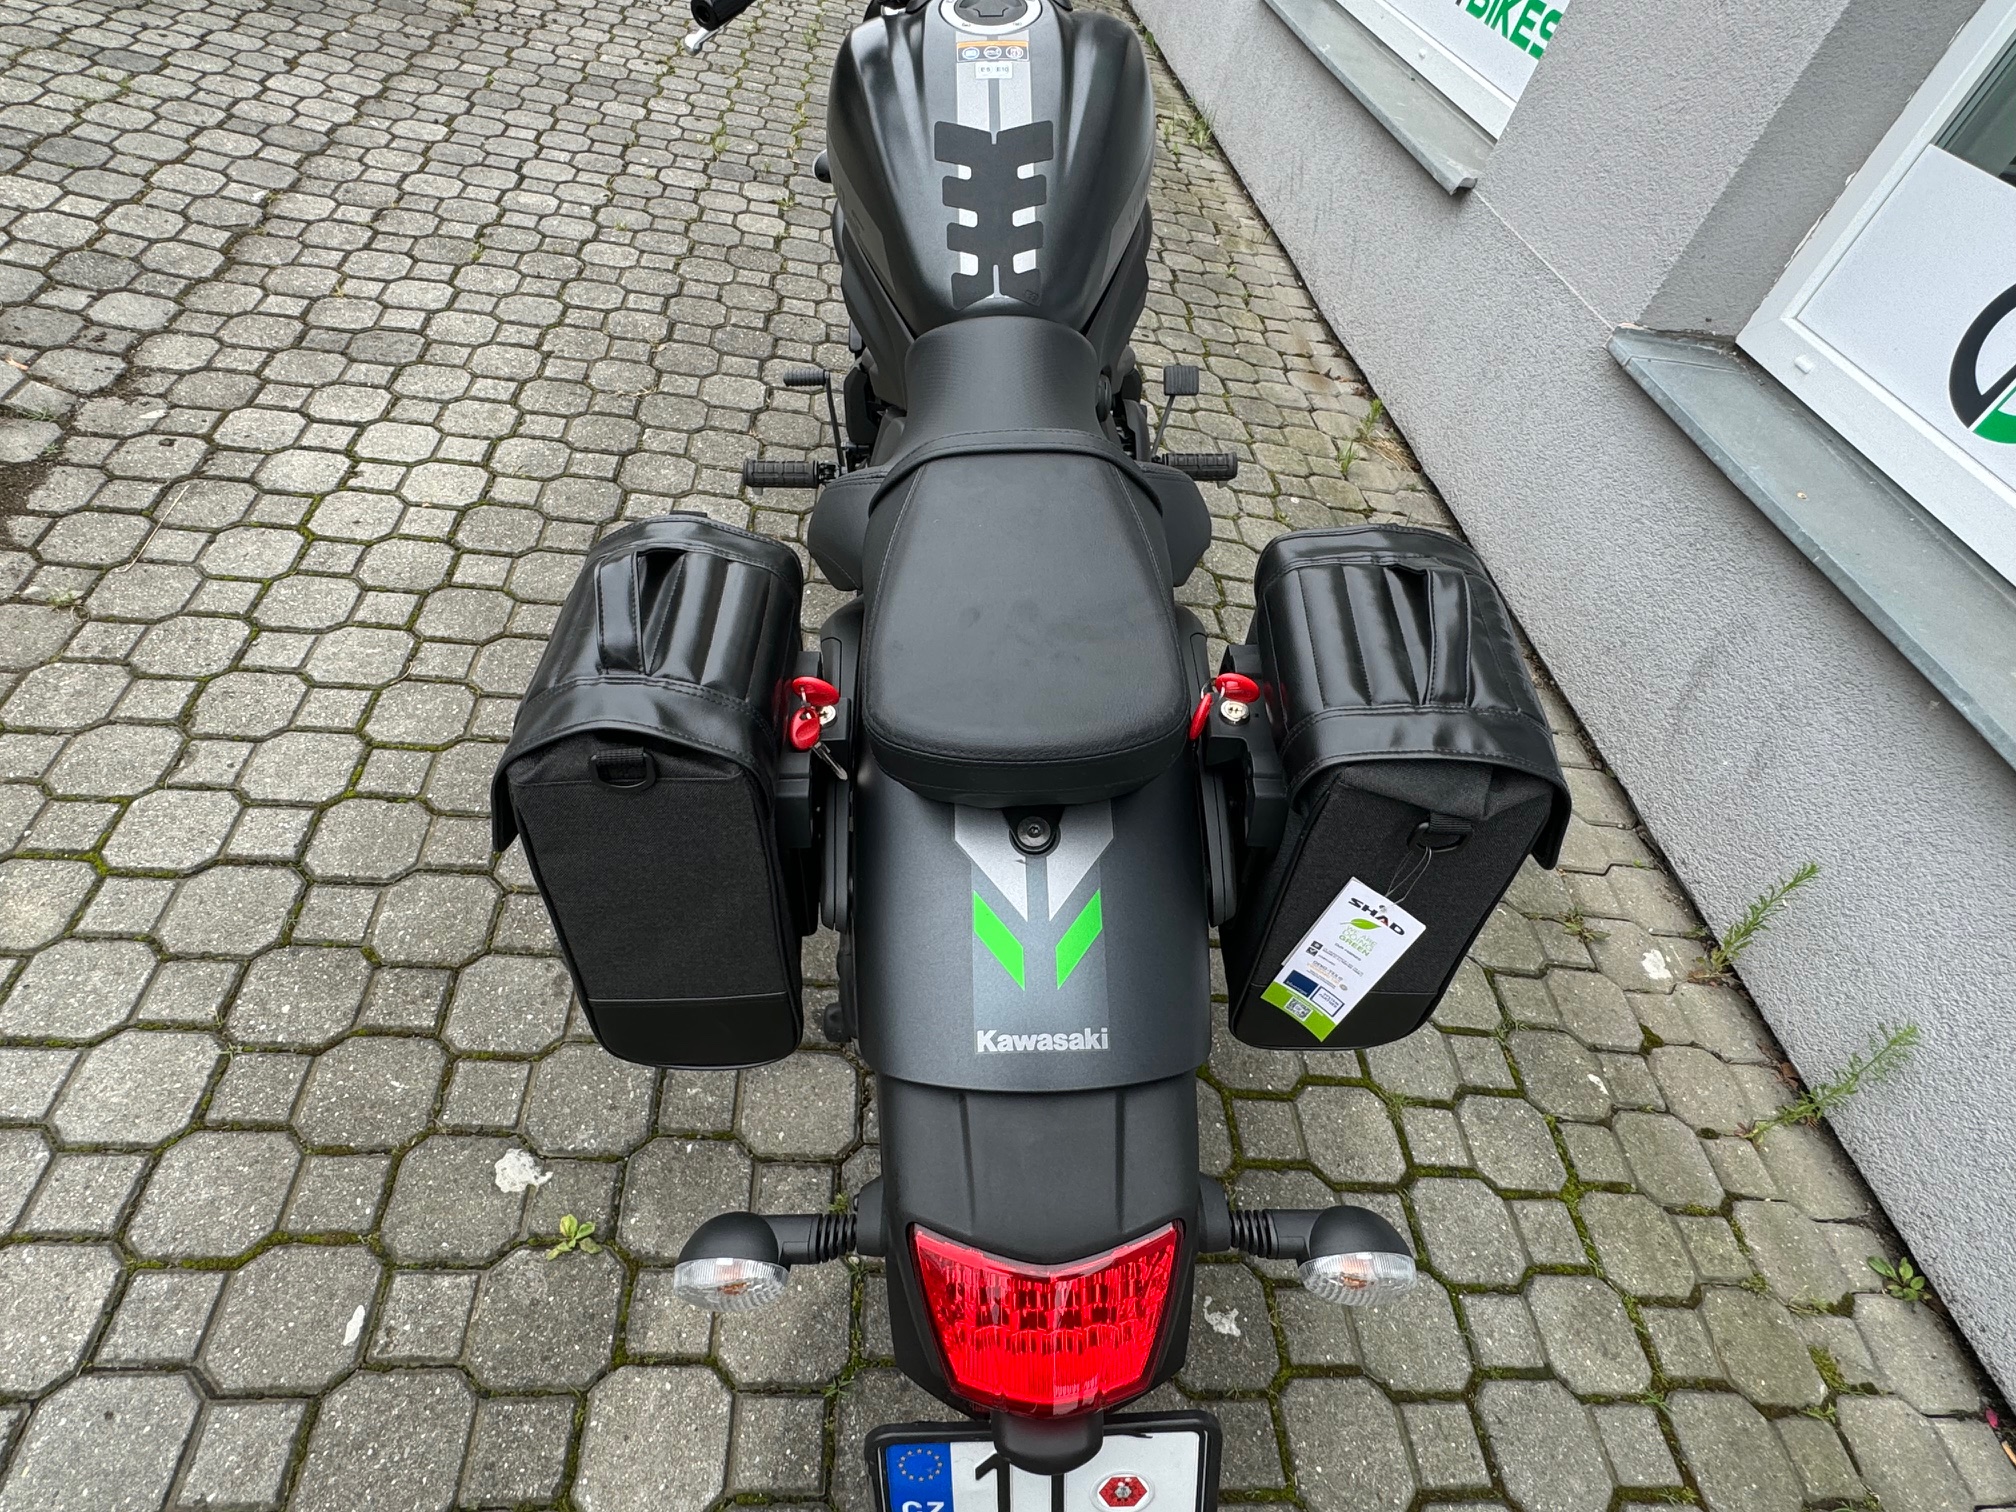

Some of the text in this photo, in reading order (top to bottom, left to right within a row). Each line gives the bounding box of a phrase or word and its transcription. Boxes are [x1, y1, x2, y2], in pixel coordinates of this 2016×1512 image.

[1348, 898, 1405, 935] SHAD
[1339, 934, 1370, 956] GREEN
[977, 1028, 1108, 1052] Kawasaki
